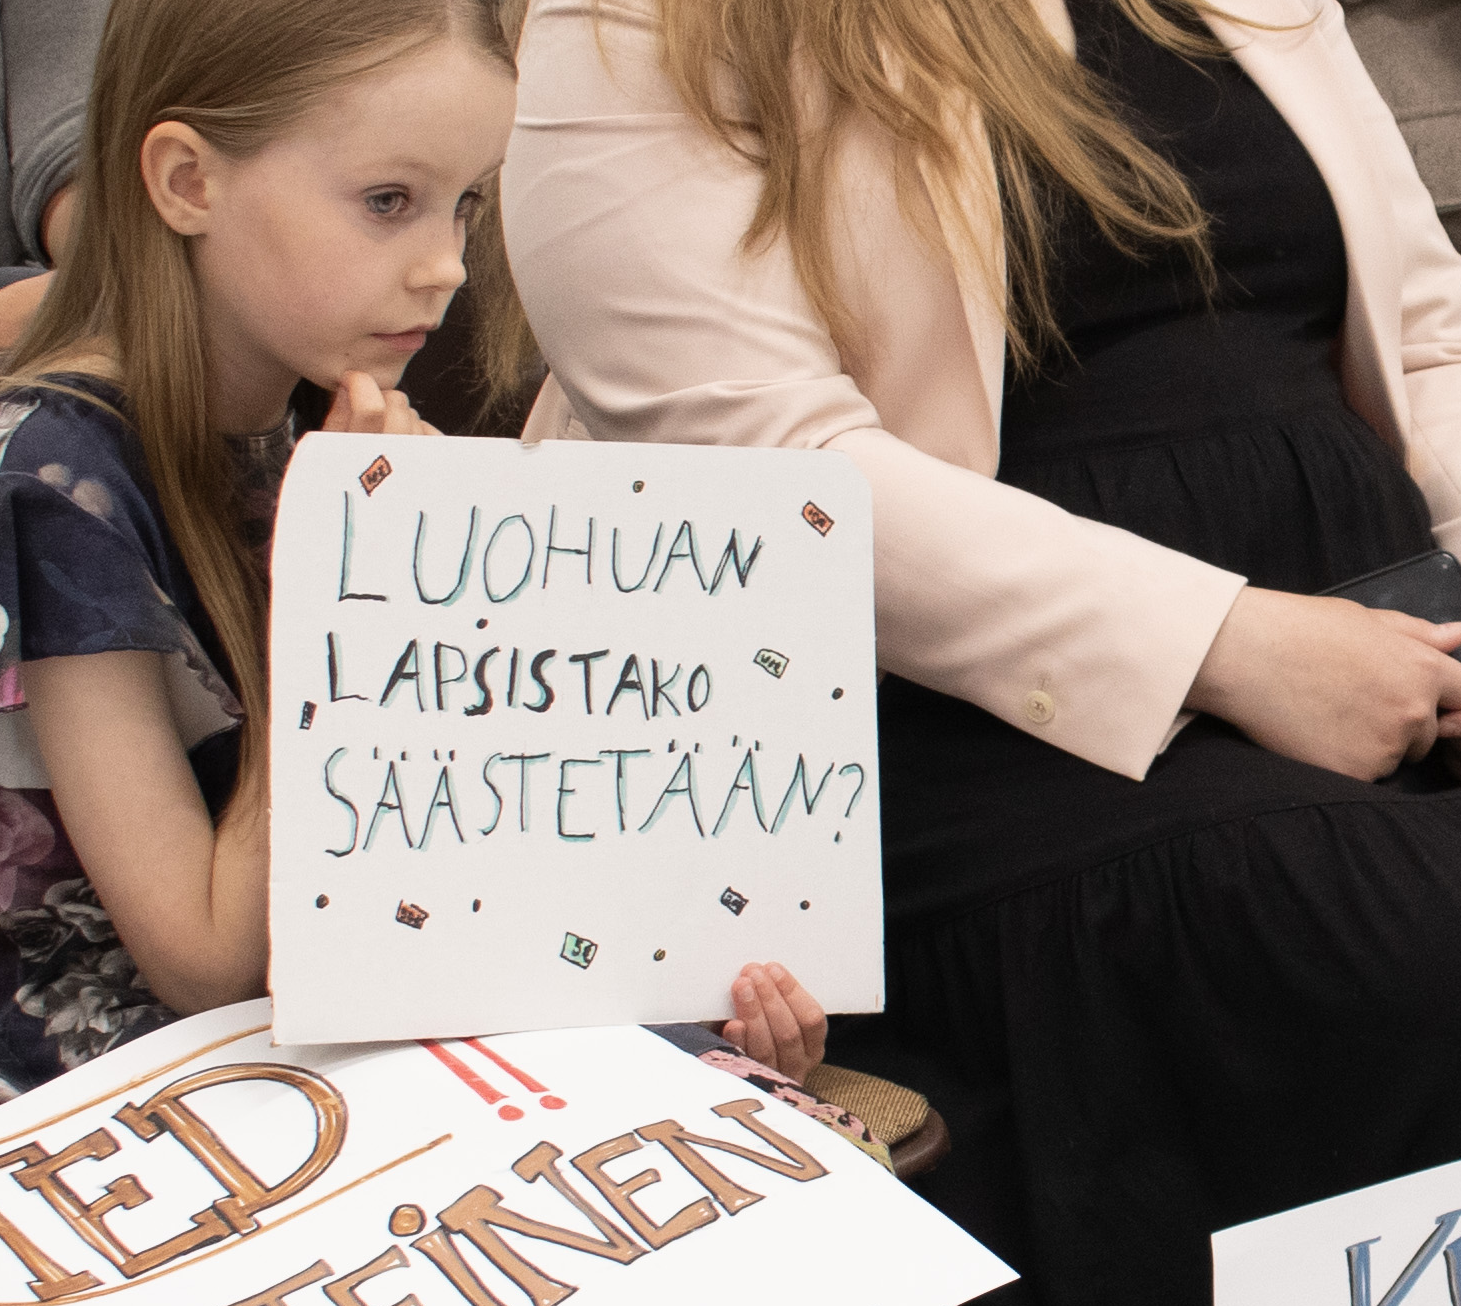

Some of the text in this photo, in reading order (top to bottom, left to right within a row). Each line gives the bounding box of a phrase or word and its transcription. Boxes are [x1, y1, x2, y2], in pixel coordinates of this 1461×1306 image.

[338, 491, 764, 607] LUOHUAN
[327, 631, 711, 720] LAPSISTAKO
[324, 735, 866, 858] SÄÄSTETÄÄN?
